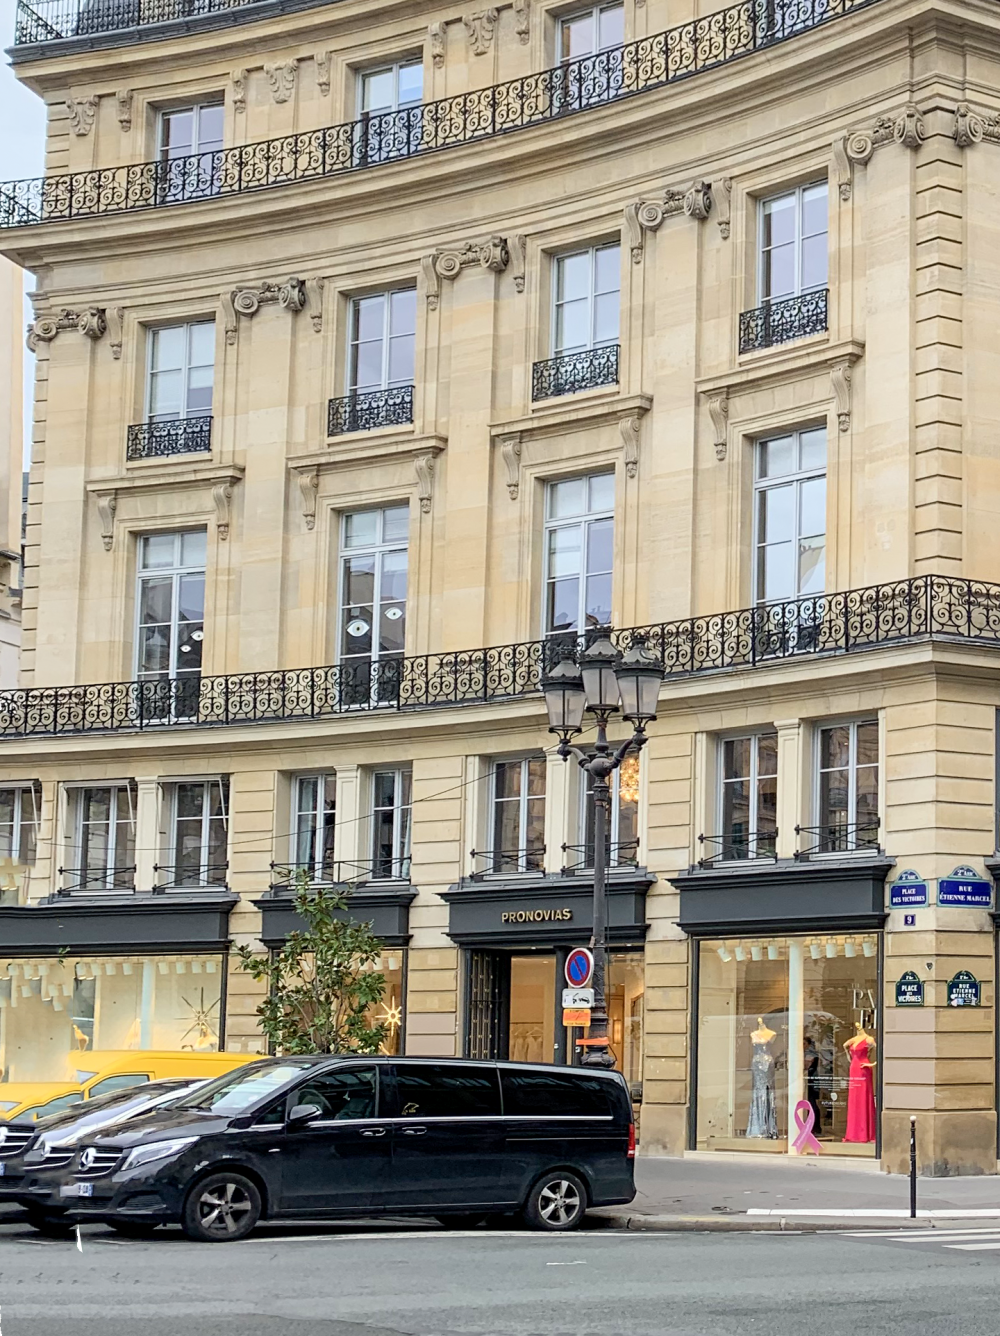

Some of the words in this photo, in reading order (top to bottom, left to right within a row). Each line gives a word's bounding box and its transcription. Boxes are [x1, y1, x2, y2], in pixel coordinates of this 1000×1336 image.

[902, 895, 925, 903] VICTOIRES
[940, 892, 966, 901] ÉTIENNE
[501, 908, 572, 923] PRONOVIAS
[907, 915, 912, 924] 9
[901, 984, 917, 992] PLACE
